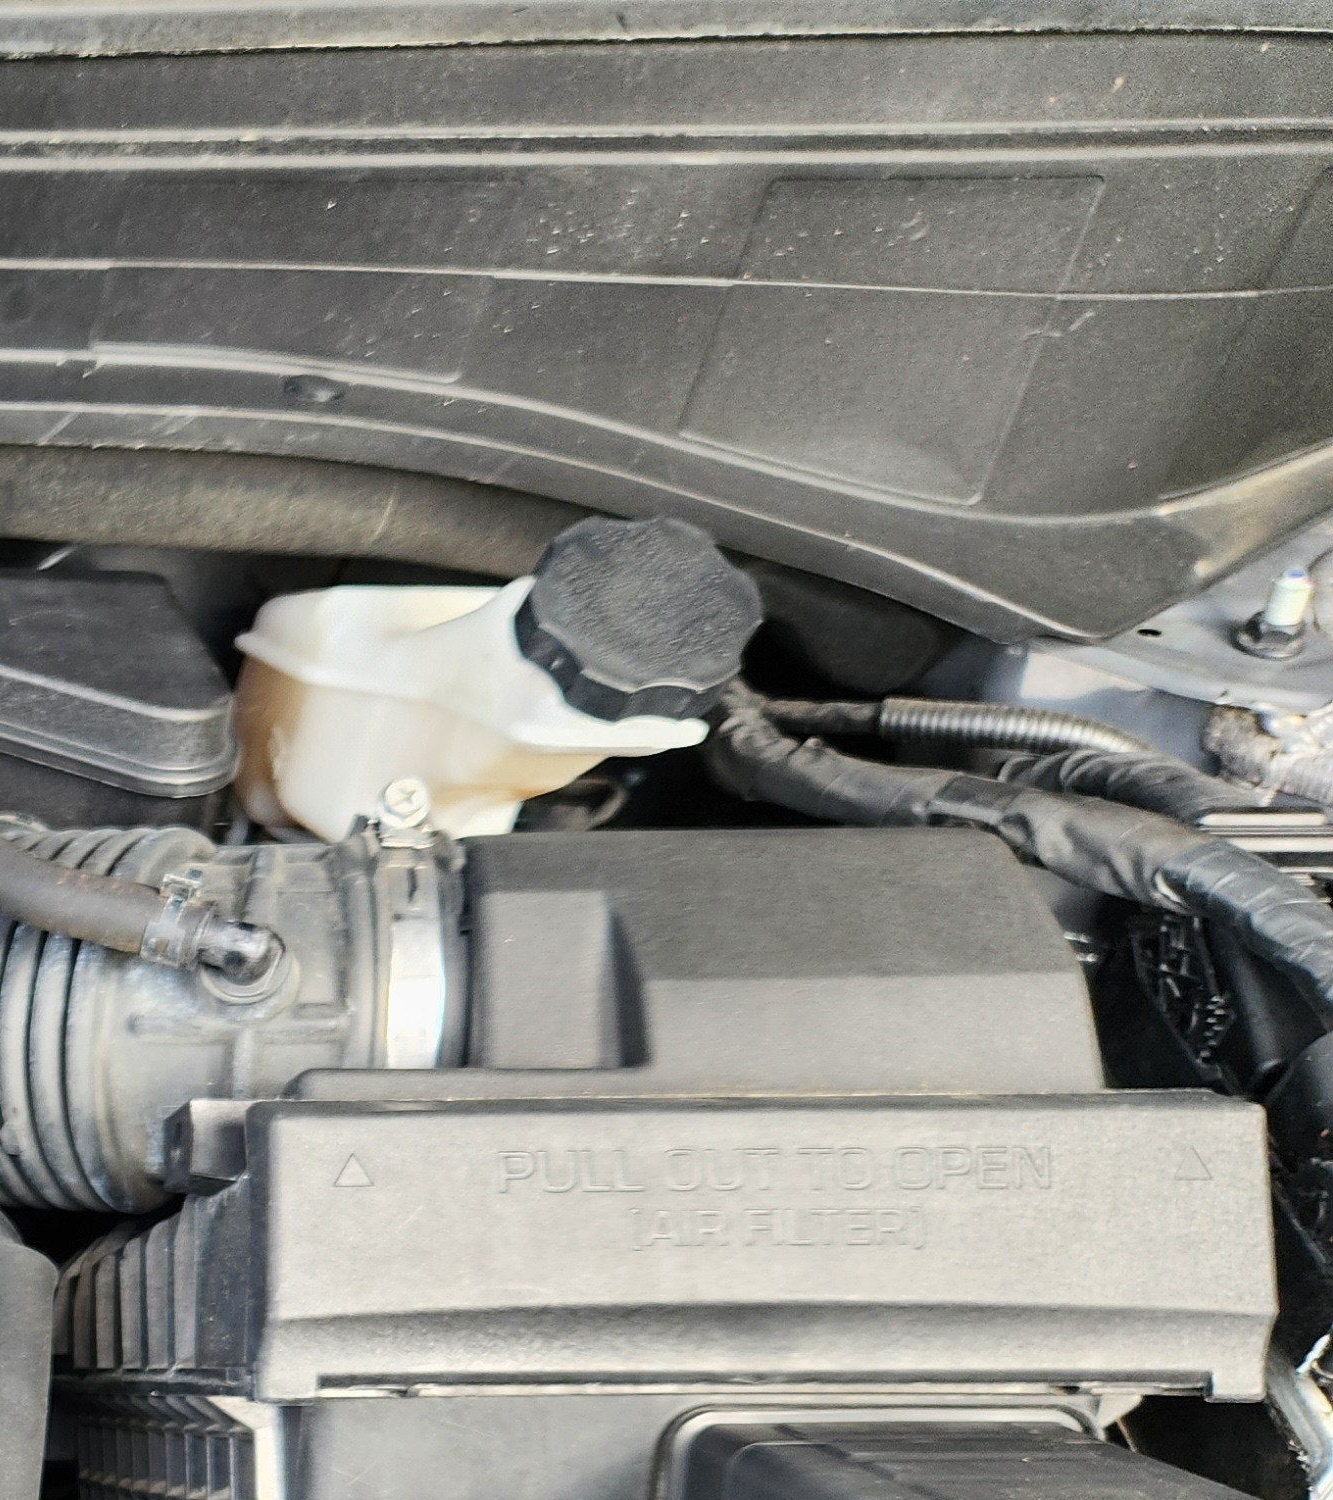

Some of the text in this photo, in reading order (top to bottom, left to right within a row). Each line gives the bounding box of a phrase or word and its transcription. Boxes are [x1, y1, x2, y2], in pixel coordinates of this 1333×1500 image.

[496, 1145, 1052, 1194] PULL OUT TO OPEN
